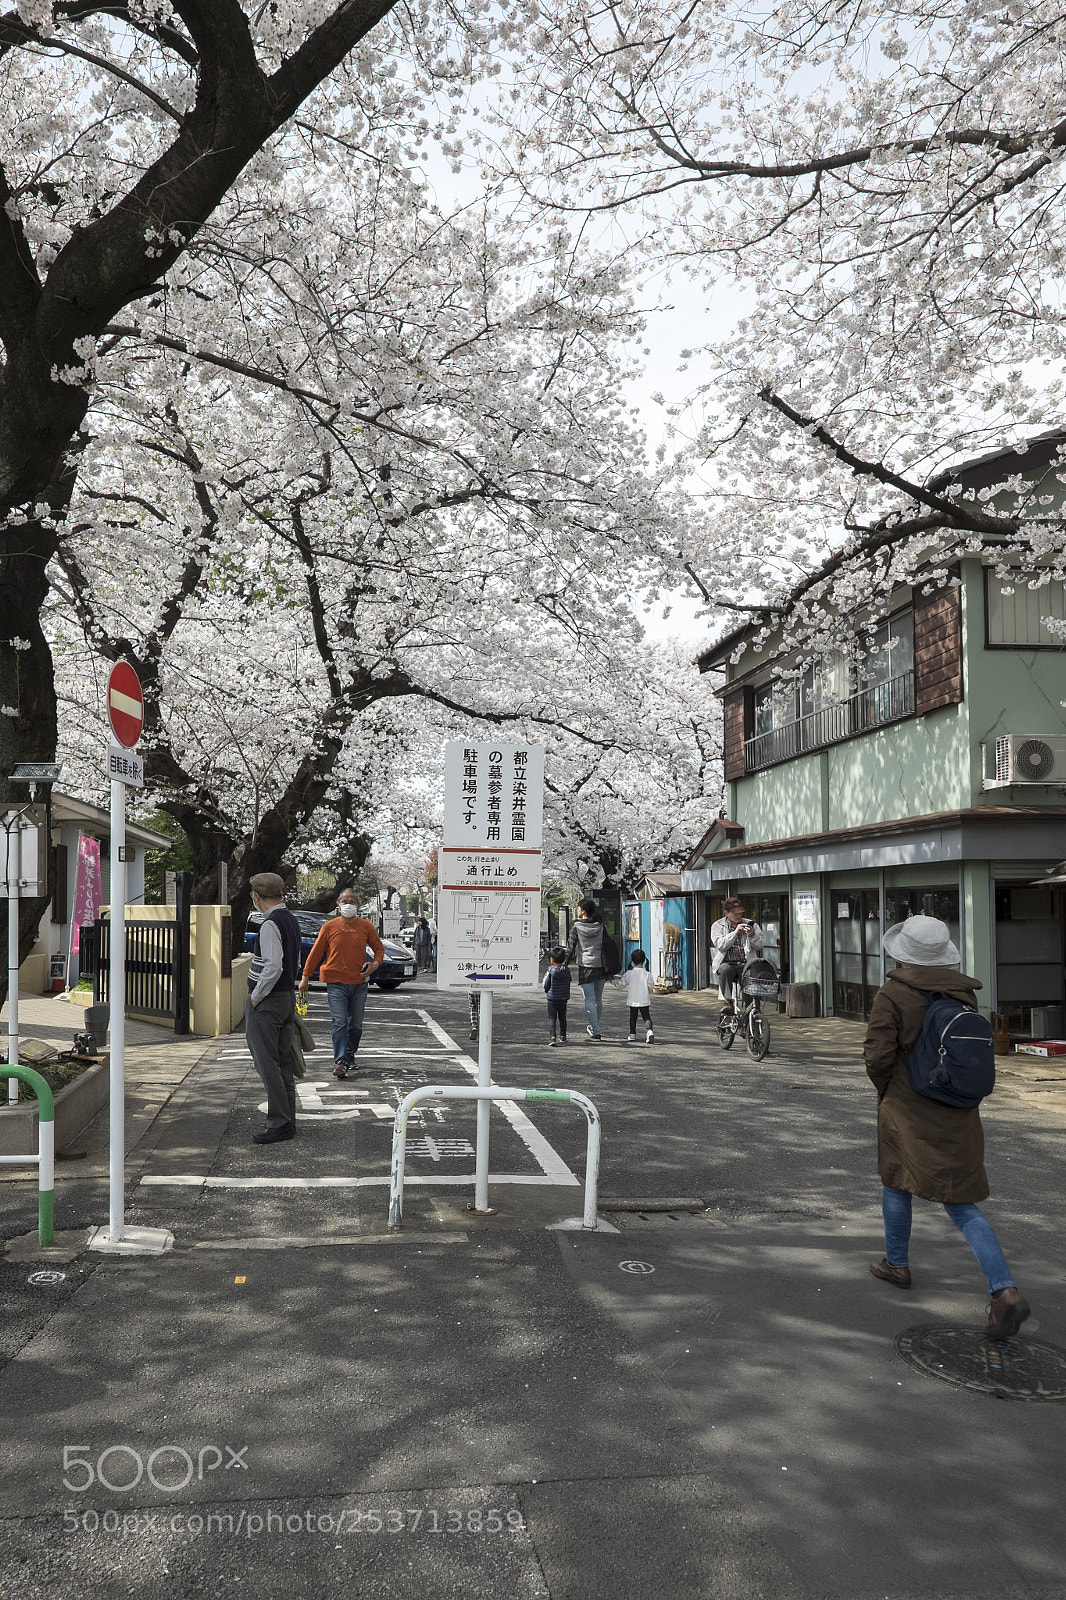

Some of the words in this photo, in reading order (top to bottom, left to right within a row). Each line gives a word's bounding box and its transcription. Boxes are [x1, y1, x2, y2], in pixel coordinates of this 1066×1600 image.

[110, 754, 143, 781] 自転車を除く
[462, 748, 478, 830] 駐車場です。
[486, 750, 503, 841] の墓参者専用
[511, 750, 528, 842] 都立染井霊園
[466, 865, 518, 877] 通行止め
[457, 962, 493, 971] 公衆トイレ
